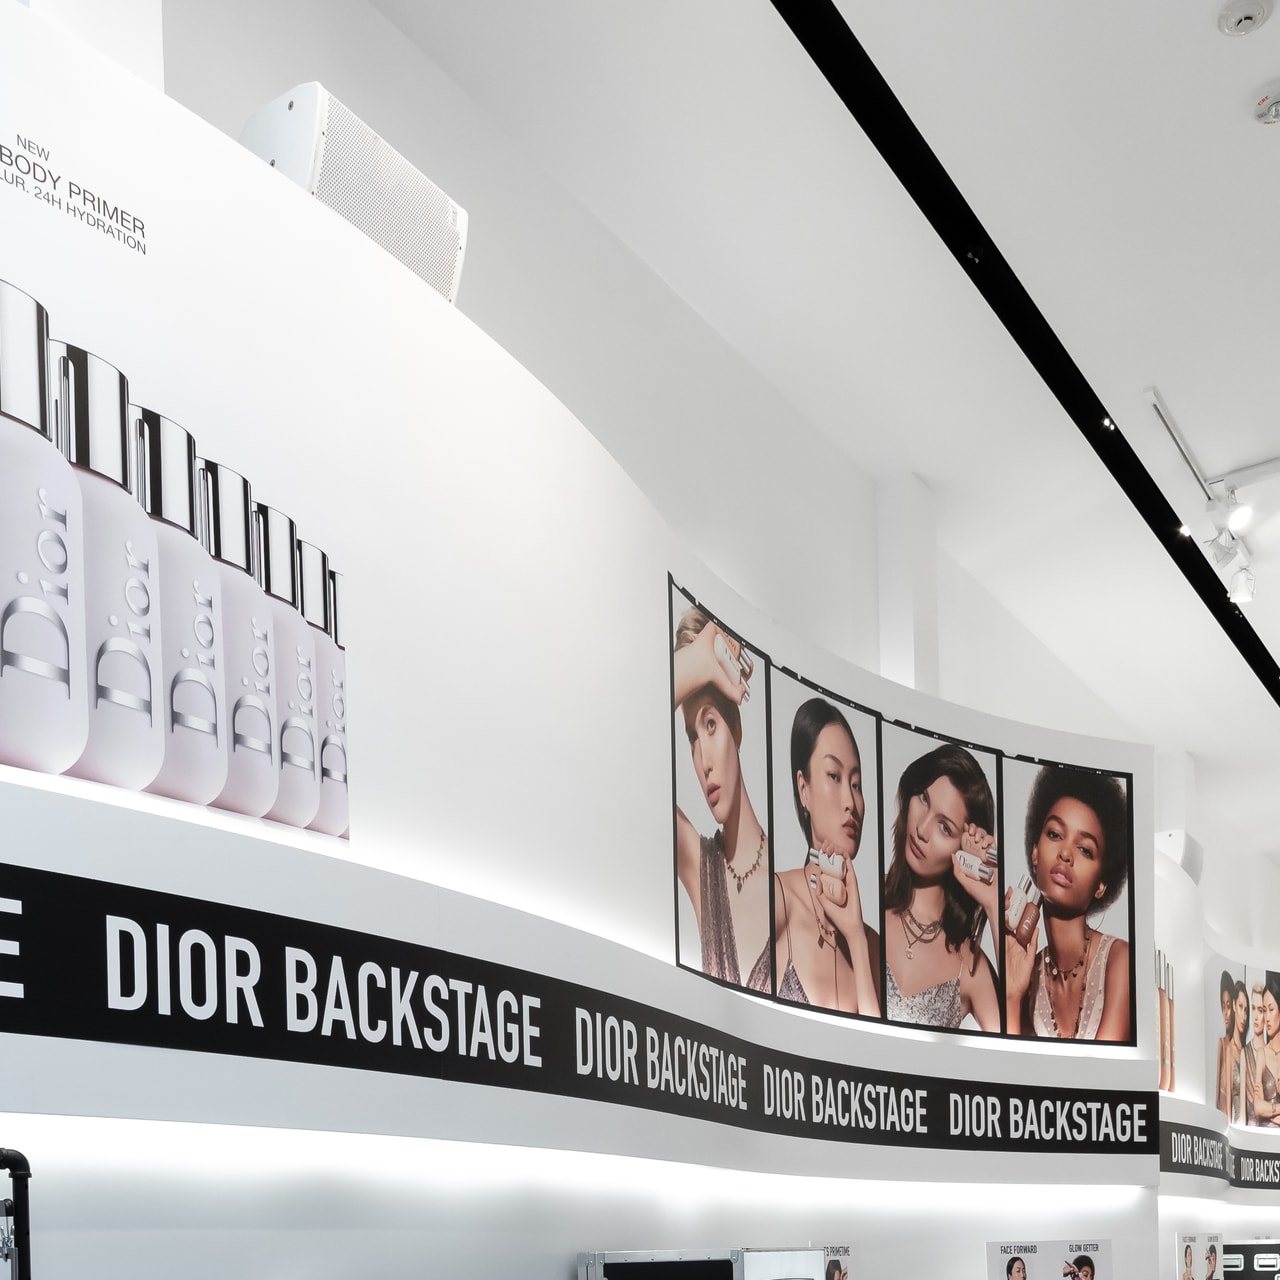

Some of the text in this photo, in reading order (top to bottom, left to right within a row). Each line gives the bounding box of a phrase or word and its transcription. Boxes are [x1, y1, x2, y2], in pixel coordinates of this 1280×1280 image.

[0, 143, 61, 191] BODY
[68, 181, 146, 239] PRIMER
[16, 133, 50, 162] NEW
[33, 186, 62, 210] 24H
[66, 204, 147, 256] HYDRATION
[0, 487, 71, 701] Dior
[95, 540, 153, 729] Dior
[171, 579, 219, 749] Dior
[233, 615, 273, 766] Dior
[280, 644, 317, 782] Dior
[320, 668, 349, 793] Dior
[105, 914, 542, 1068] DIOR BACKSTAGE
[576, 1007, 748, 1111] DIOR BACKSTAGE
[763, 1064, 928, 1134] DIOR BACKSTAGE
[949, 1092, 1148, 1143] DIOR BACKSTAGE
[1171, 1132, 1192, 1165] DIOR
[1193, 1137, 1223, 1171] BACKSTAGE
[1241, 1157, 1254, 1182] DIOR
[1000, 1245, 1037, 1254] FACE FORWARD
[1069, 1243, 1099, 1252] GLOW GETTER
